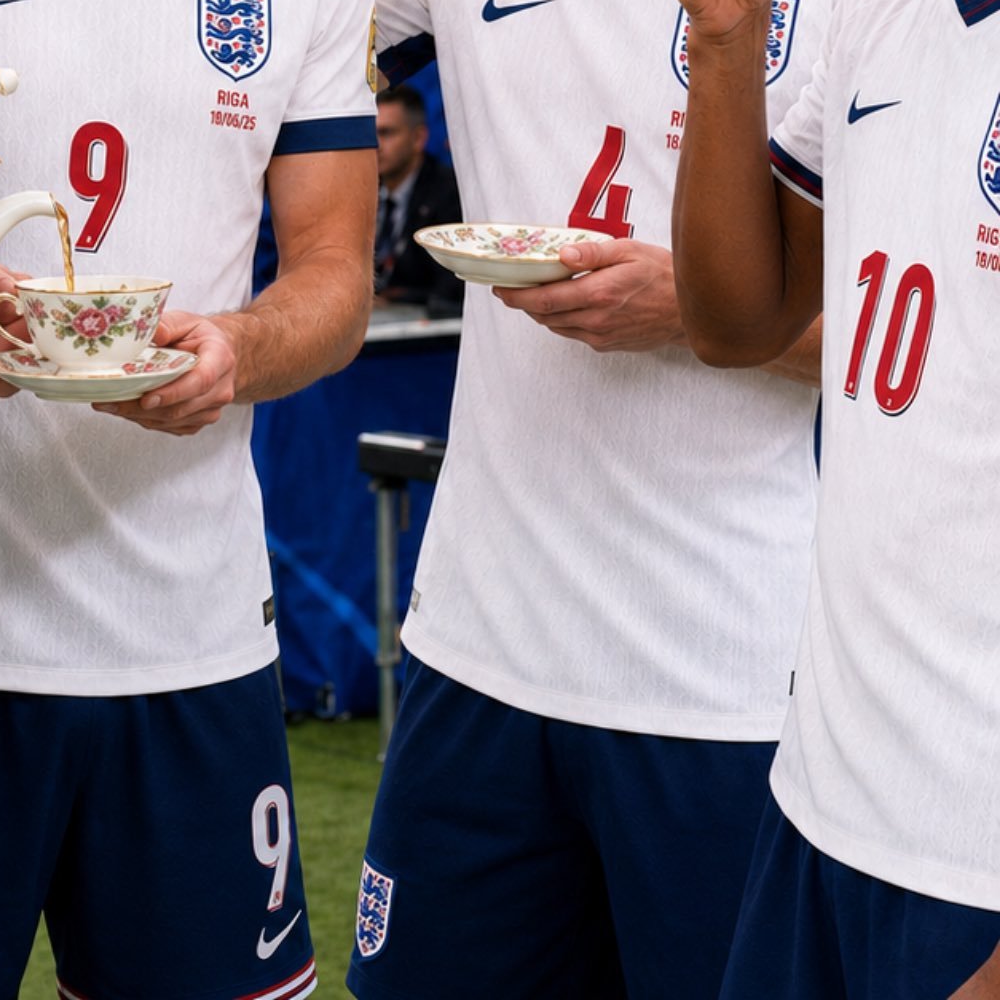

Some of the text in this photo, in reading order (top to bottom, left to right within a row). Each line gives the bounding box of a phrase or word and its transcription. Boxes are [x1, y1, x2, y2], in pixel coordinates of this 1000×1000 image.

[217, 89, 250, 109] RIGA
[670, 110, 685, 128] RI
[665, 133, 681, 150] 18
[68, 120, 128, 253] 9
[567, 124, 634, 240] 4
[976, 223, 1000, 246] RIG
[975, 250, 1000, 272] 18/0
[844, 249, 936, 416] 10
[252, 783, 291, 912] 9
